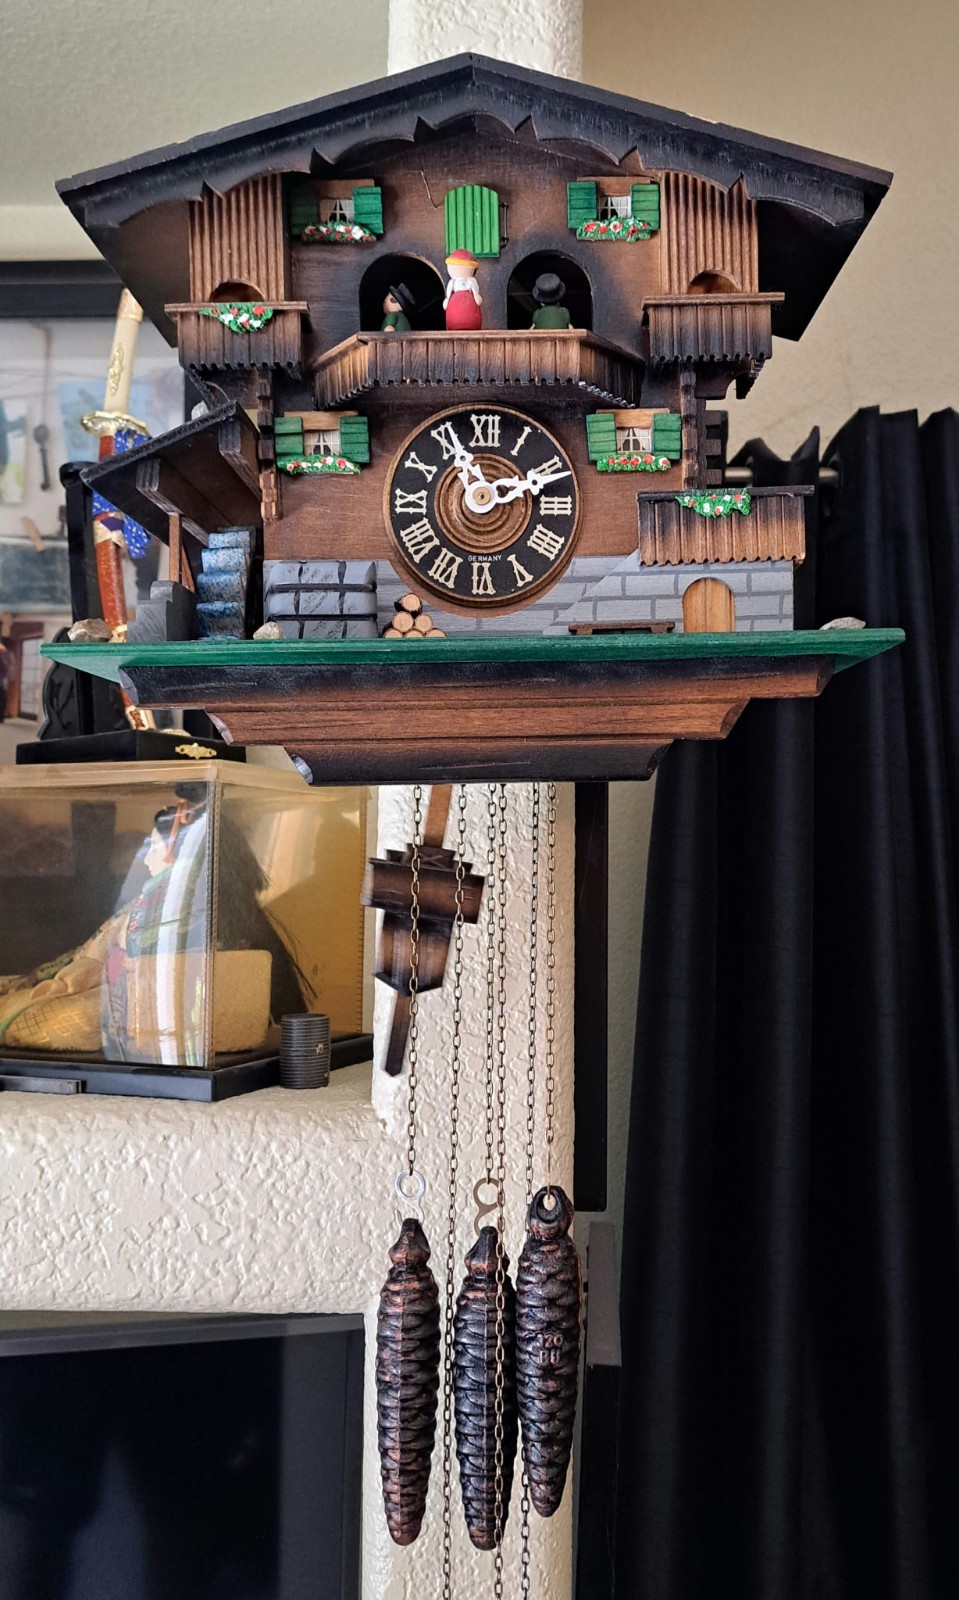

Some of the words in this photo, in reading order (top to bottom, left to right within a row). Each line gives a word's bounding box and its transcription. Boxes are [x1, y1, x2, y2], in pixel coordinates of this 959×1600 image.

[468, 413, 502, 448] XII
[510, 426, 533, 455] I
[404, 451, 438, 483] X
[394, 488, 428, 515] IX
[539, 494, 573, 517] III
[399, 517, 440, 563] VIII
[527, 523, 565, 561] IIII
[427, 547, 463, 589] VII
[467, 554, 502, 563] GERMANY
[507, 553, 534, 587] V
[470, 562, 496, 594] VI
